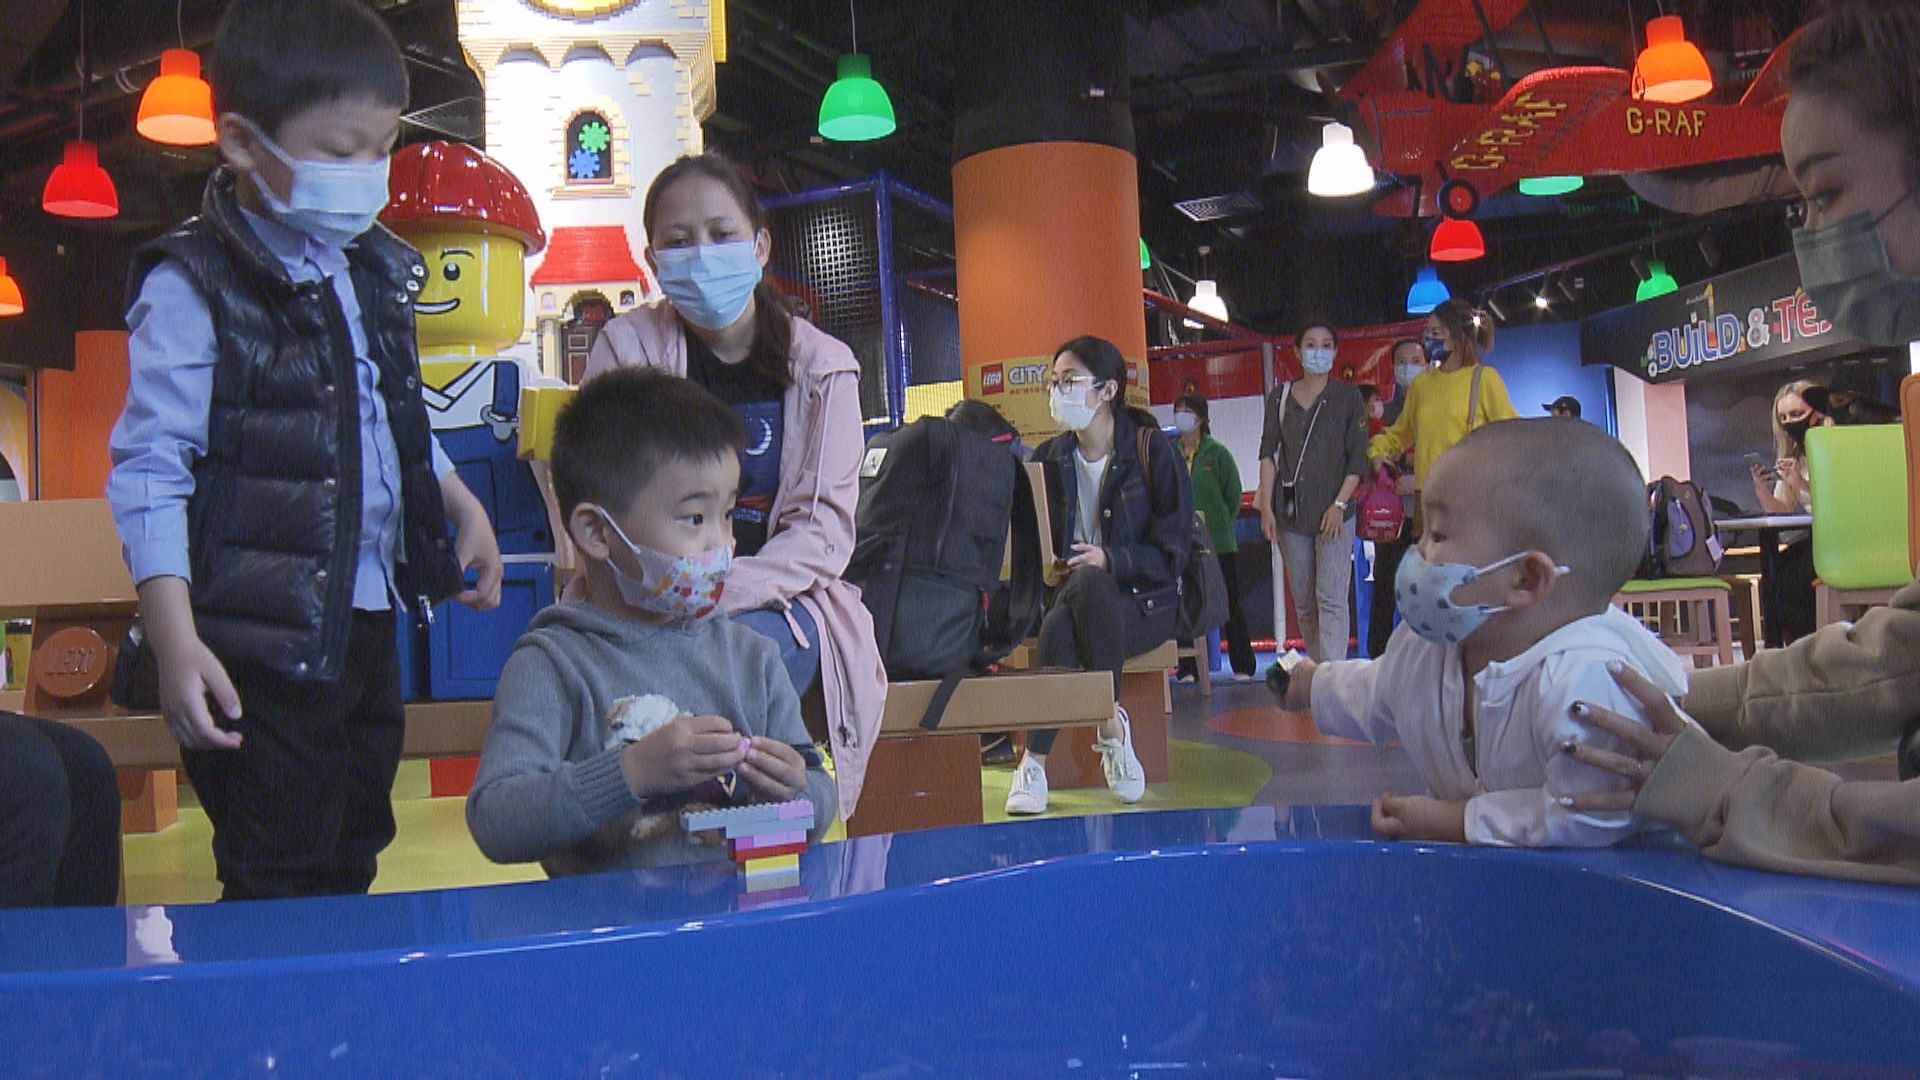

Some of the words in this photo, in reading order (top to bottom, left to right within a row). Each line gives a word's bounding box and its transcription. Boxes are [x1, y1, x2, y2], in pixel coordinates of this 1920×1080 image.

[1626, 107, 1706, 137] G-RAF
[1747, 308, 1770, 347] &
[1773, 292, 1832, 344] TE
[983, 370, 1002, 387] LEGO
[1008, 364, 1048, 385] CITY
